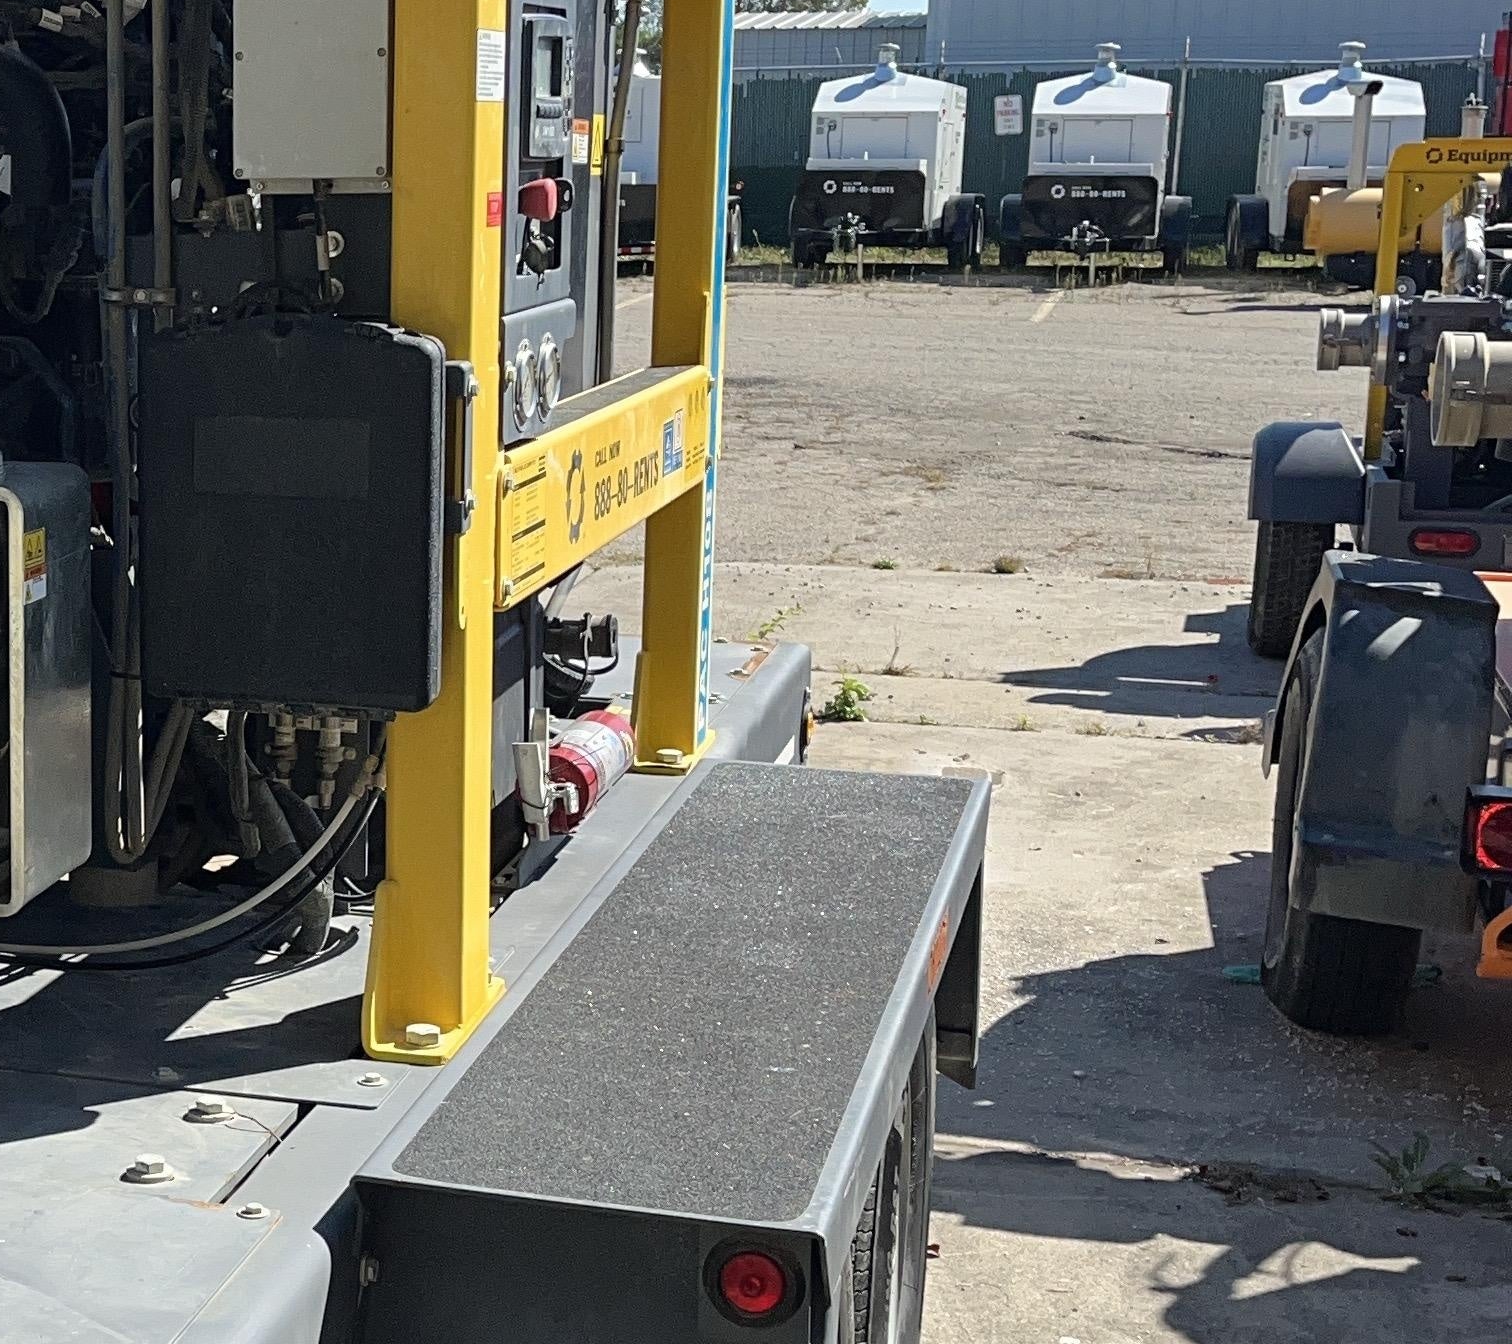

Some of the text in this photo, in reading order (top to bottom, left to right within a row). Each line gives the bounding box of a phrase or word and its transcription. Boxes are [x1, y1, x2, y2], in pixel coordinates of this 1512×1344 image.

[595, 440, 620, 468] CALL NOW
[595, 450, 659, 521] 888-80-RENTS
